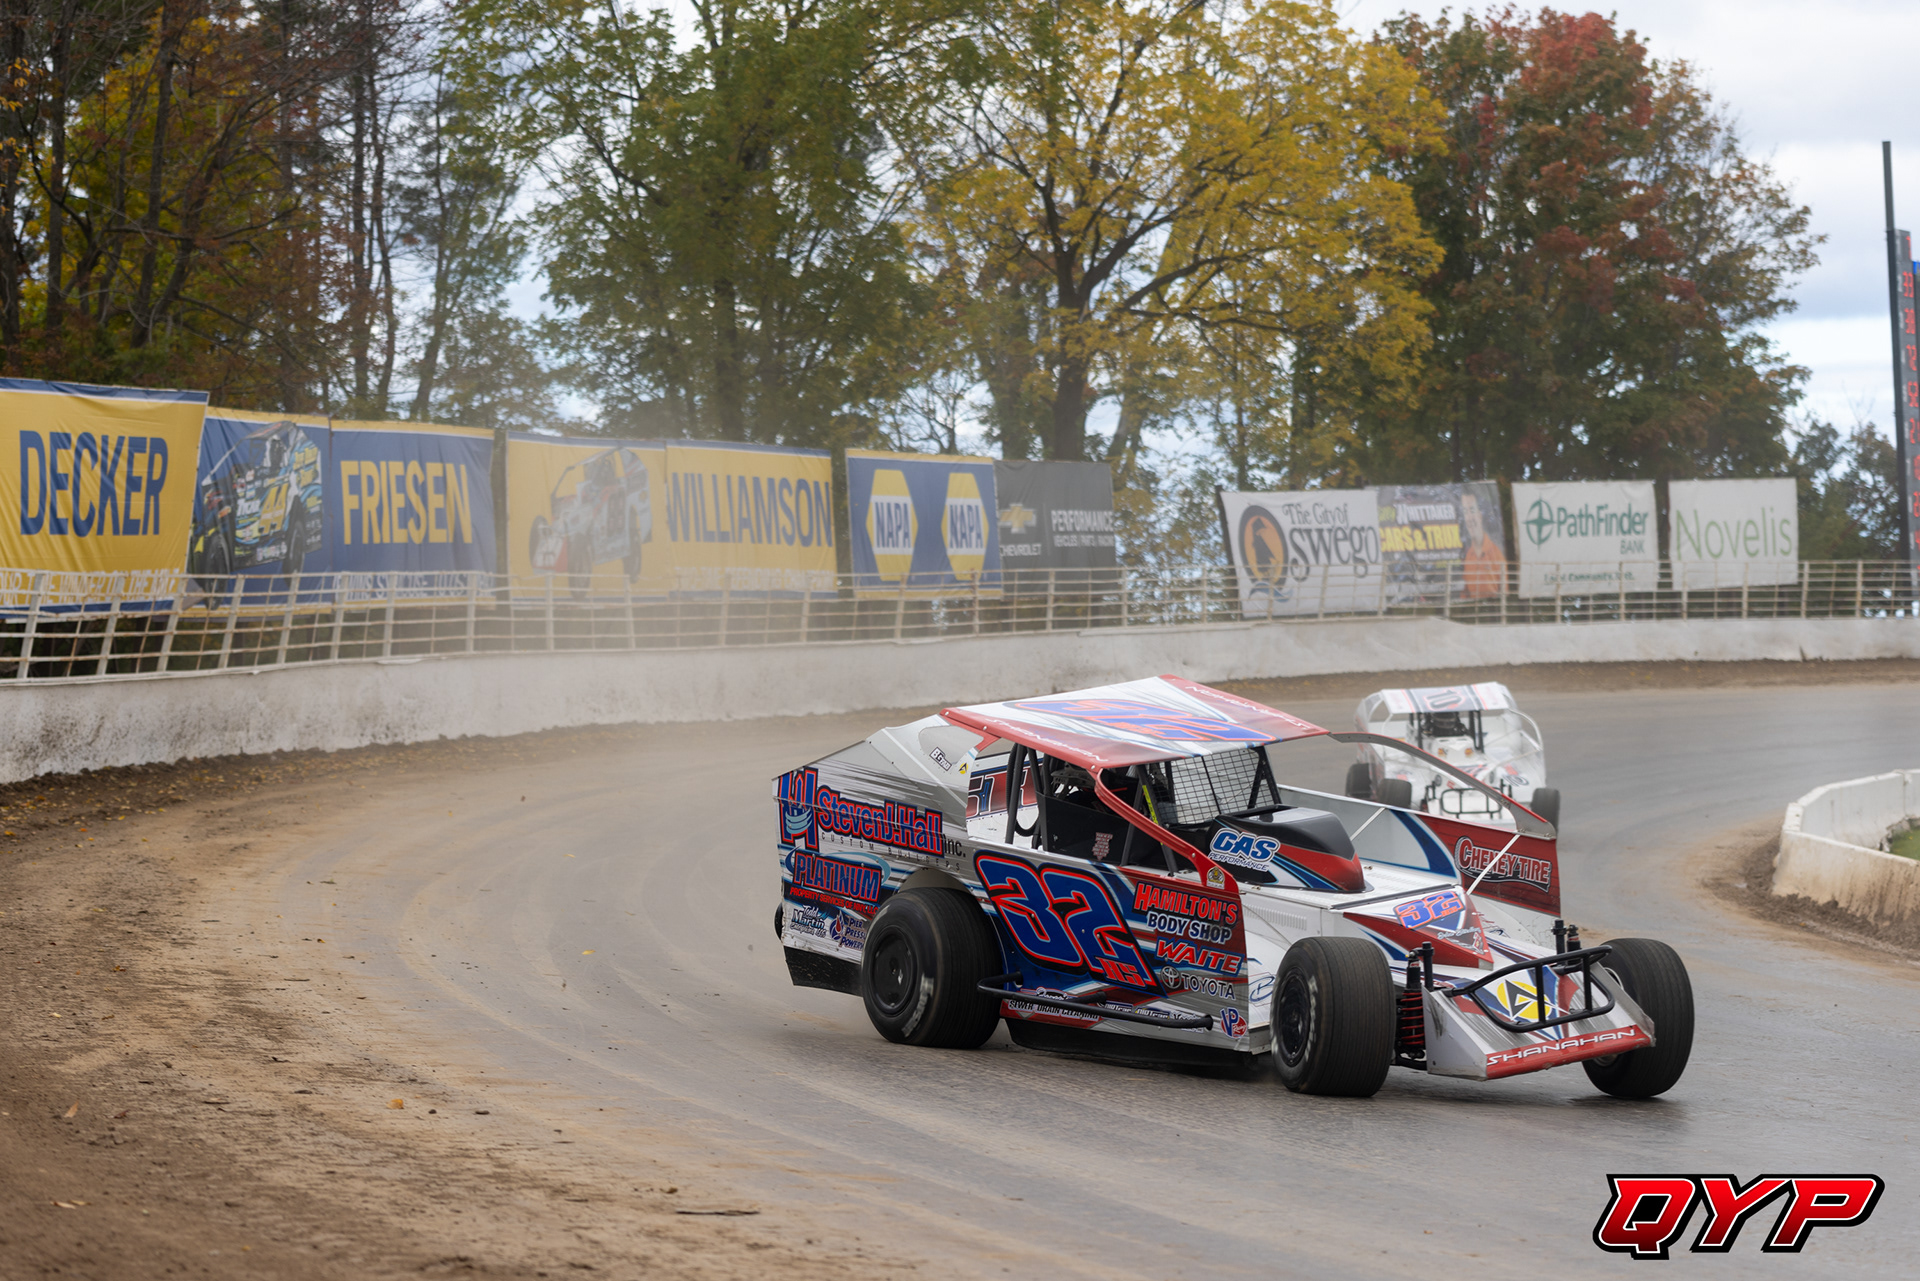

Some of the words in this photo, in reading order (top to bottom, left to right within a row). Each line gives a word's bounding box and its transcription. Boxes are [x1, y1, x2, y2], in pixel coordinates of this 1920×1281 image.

[19, 430, 169, 537] DECKER
[340, 460, 474, 545] FRIESEN
[666, 472, 834, 548] WILLIAMSON
[1283, 503, 1311, 526] The
[1312, 502, 1338, 528] City
[1392, 503, 1457, 525] WHITTAKER
[874, 502, 912, 549] NAPA
[948, 504, 984, 550] NAPA
[1051, 510, 1114, 532] PERFORMANCE
[1556, 503, 1648, 539] PathFinder
[1675, 507, 1794, 562] Novelis
[1379, 525, 1414, 553] CARS
[1413, 528, 1427, 551] &
[1620, 540, 1645, 555] BANK
[821, 832, 875, 851] CUSTOM
[1211, 828, 1280, 862] GAS
[793, 852, 882, 904] PLATINUM
[1208, 852, 1270, 872] PERFORMANCE
[1458, 838, 1517, 877] CHENEY
[1518, 857, 1552, 884] TIRE
[789, 887, 819, 903] PROPERTY
[820, 892, 844, 908] SERVICES
[845, 900, 854, 909] OF
[803, 905, 818, 918] Todd
[1133, 881, 1239, 925] HAMILTON'S
[1393, 890, 1466, 931] 32
[792, 909, 826, 929] Martin
[849, 917, 864, 928] PIER
[974, 851, 1166, 995] 32
[1147, 913, 1189, 937] BODY
[1189, 920, 1232, 944] SHOP
[1156, 938, 1243, 975] WAITE
[1181, 974, 1236, 1001] TOYOTA
[1221, 1008, 1239, 1037] VP
[1487, 1028, 1637, 1066] SHANAHAN
